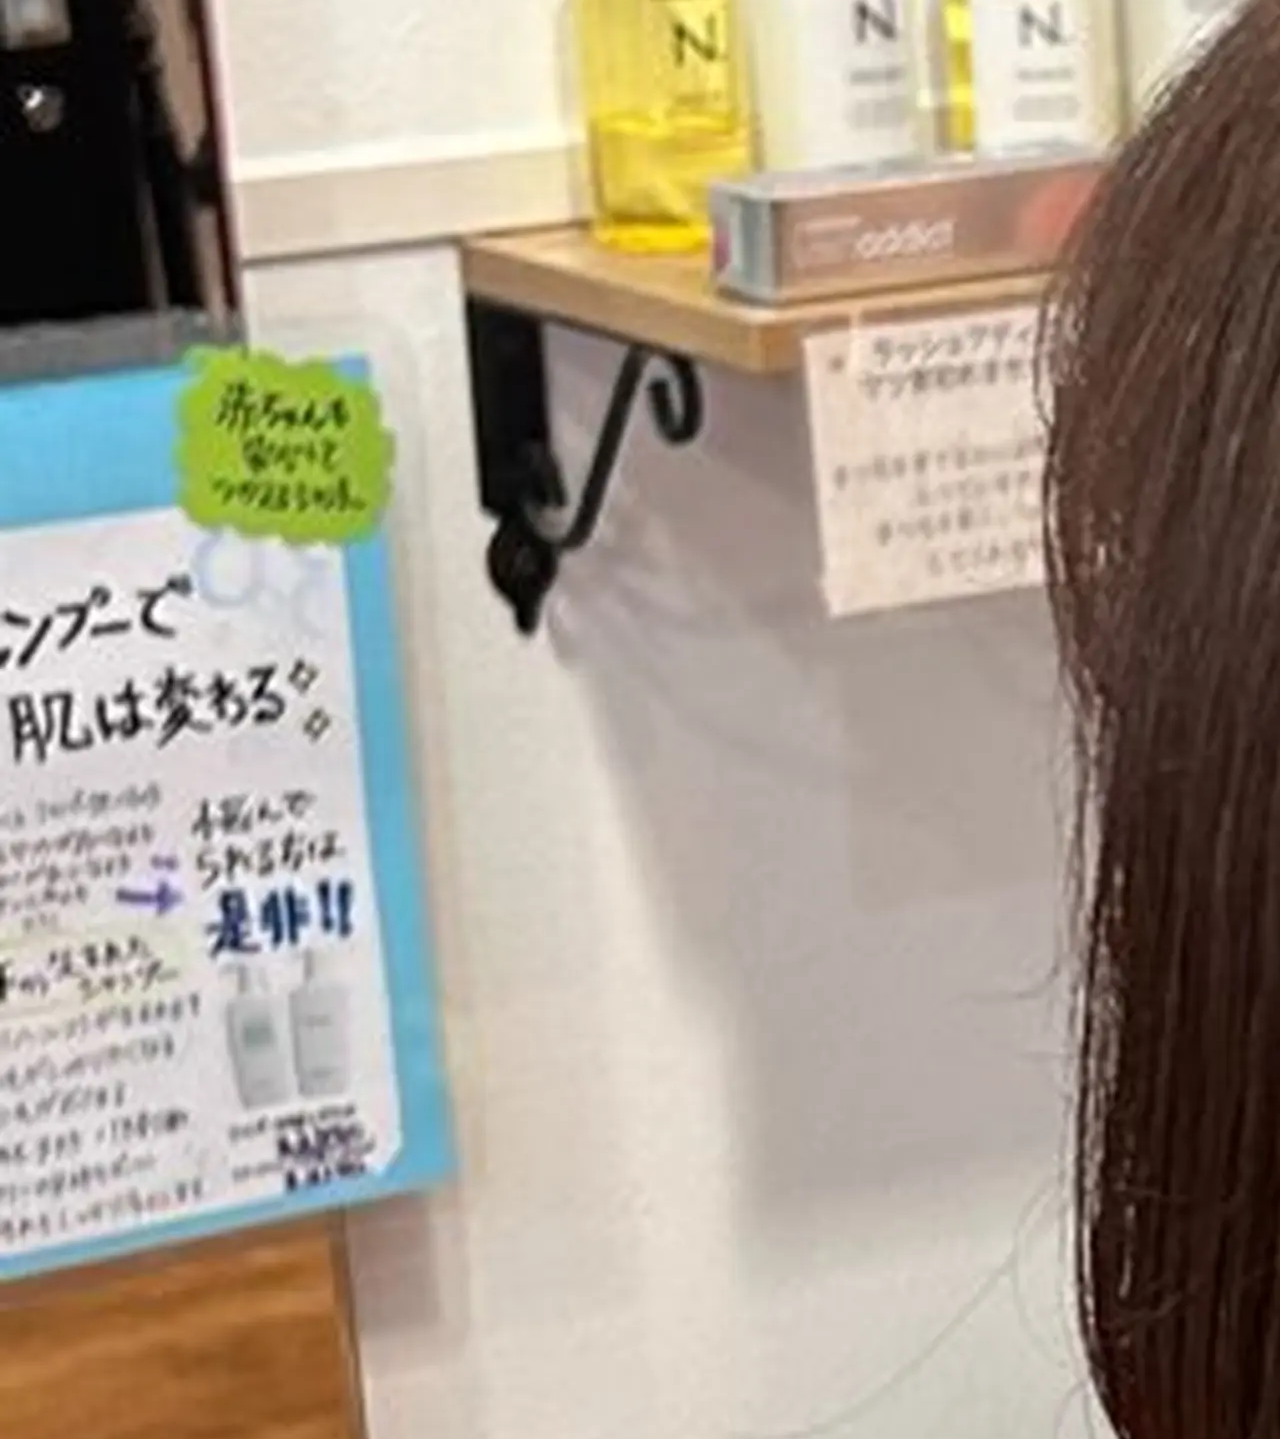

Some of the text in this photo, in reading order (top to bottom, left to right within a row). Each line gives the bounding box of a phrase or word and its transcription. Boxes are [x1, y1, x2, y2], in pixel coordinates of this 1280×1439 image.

[0, 573, 193, 668] ンプーで
[8, 664, 286, 765] 肌は変わる
